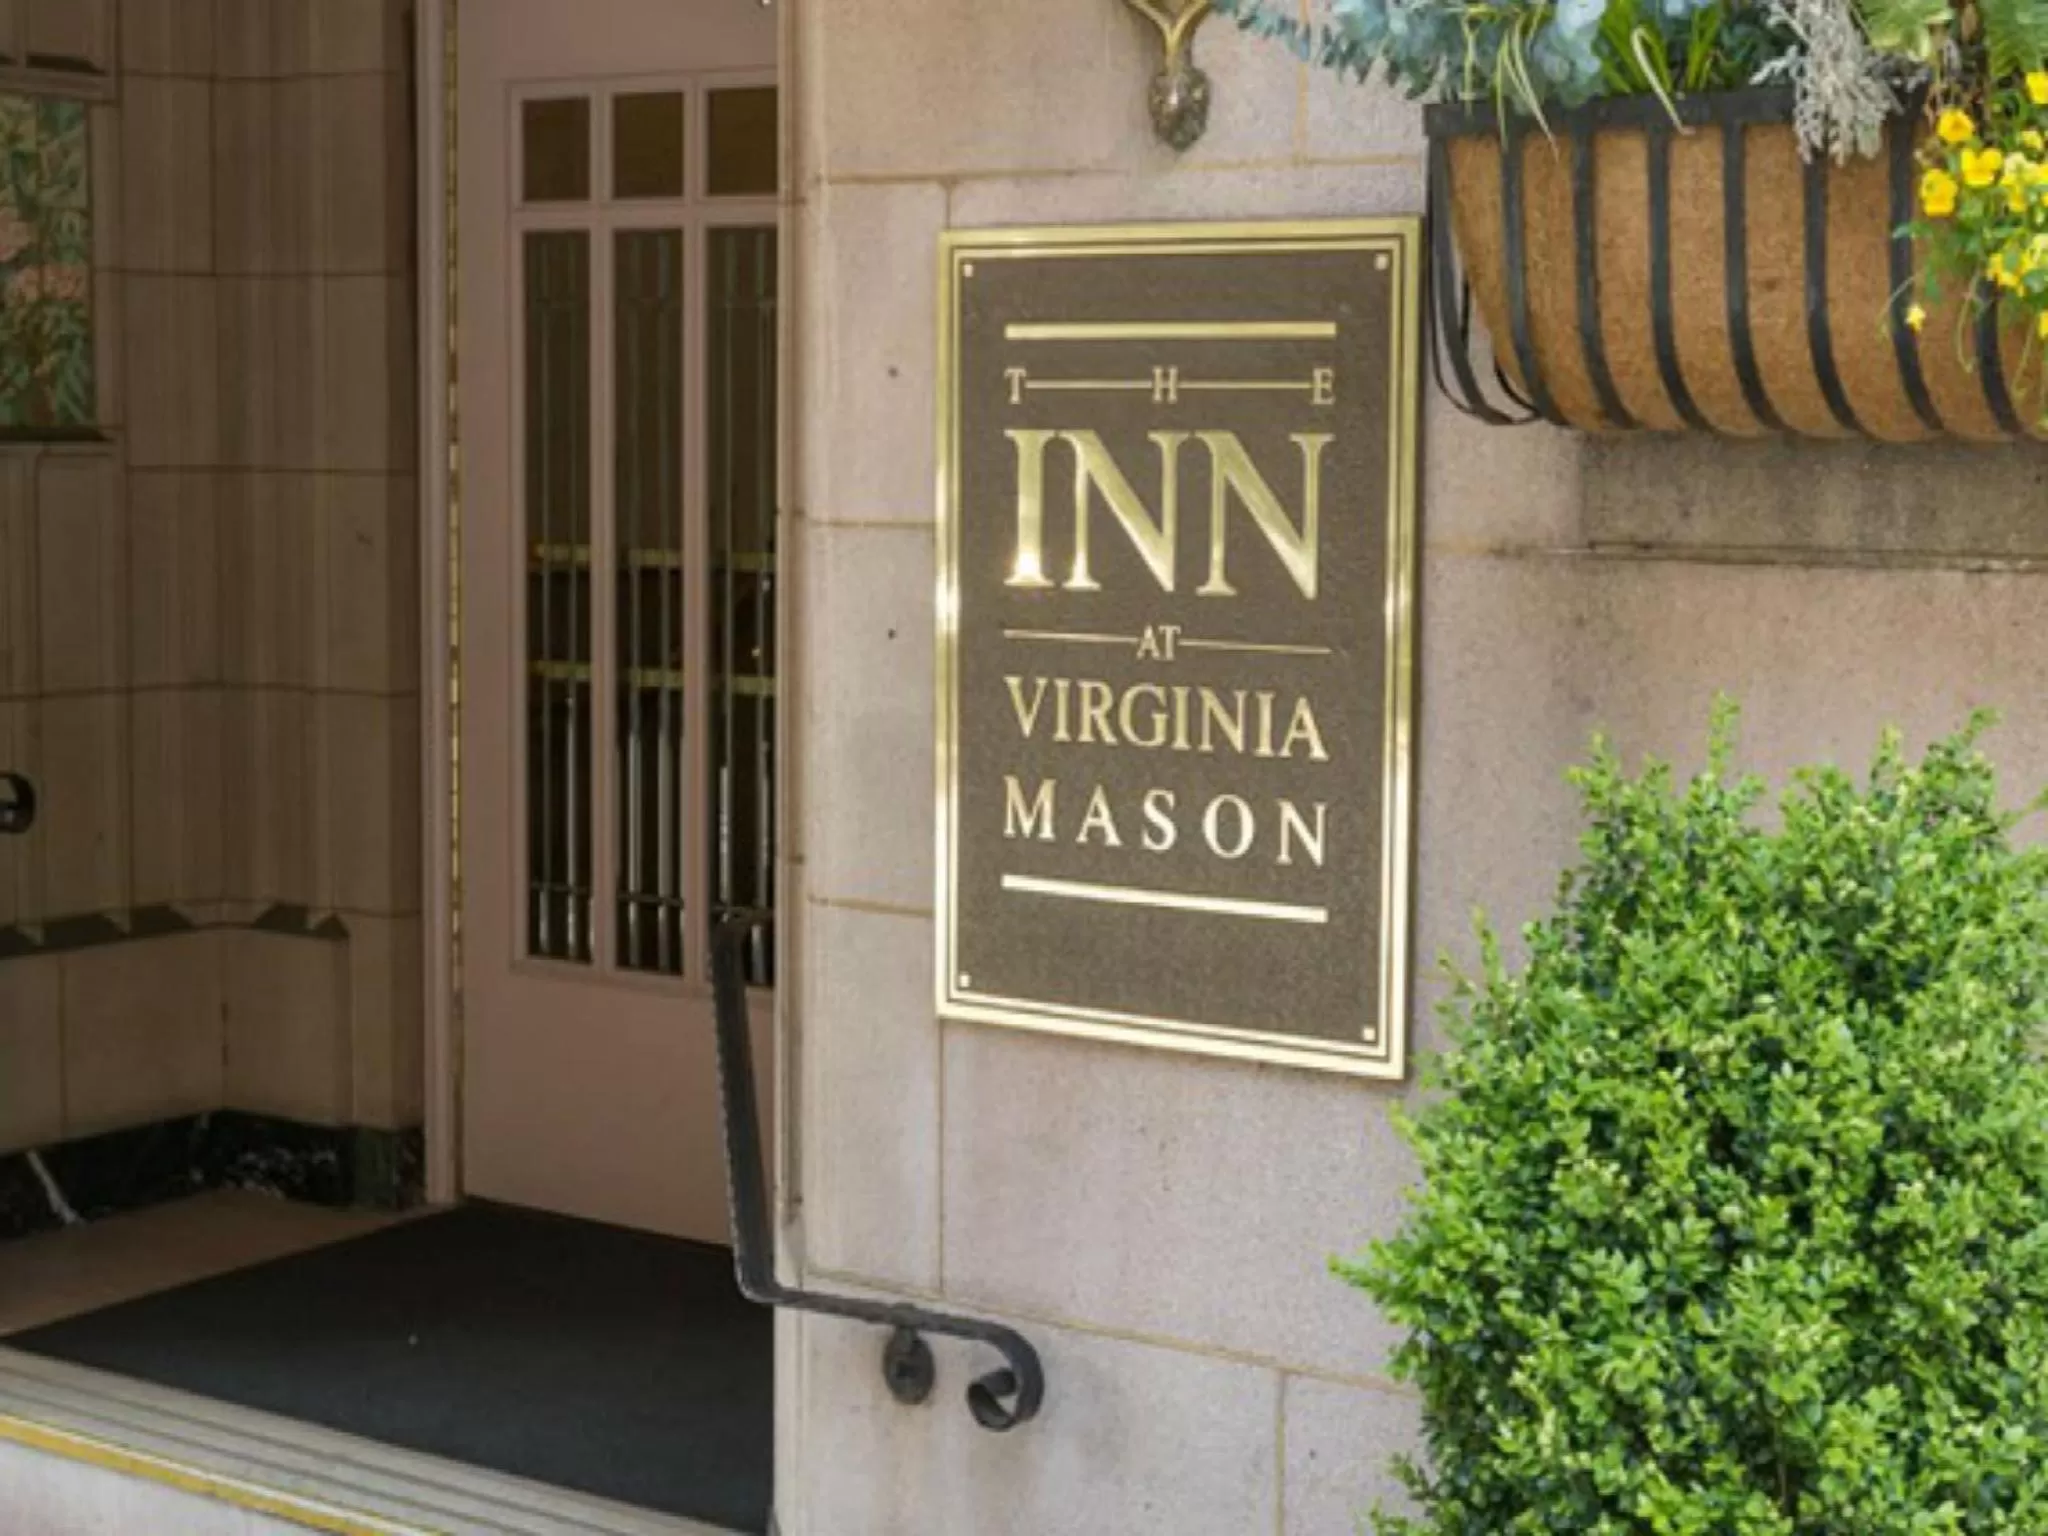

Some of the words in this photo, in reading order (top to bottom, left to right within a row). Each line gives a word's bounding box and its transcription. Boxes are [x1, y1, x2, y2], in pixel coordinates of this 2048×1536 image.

[1004, 366, 1336, 404] THE
[1003, 429, 1336, 600] INN
[1136, 625, 1181, 661] AT
[1003, 676, 1329, 761] VIRGINIA
[1003, 775, 1327, 867] MASON
